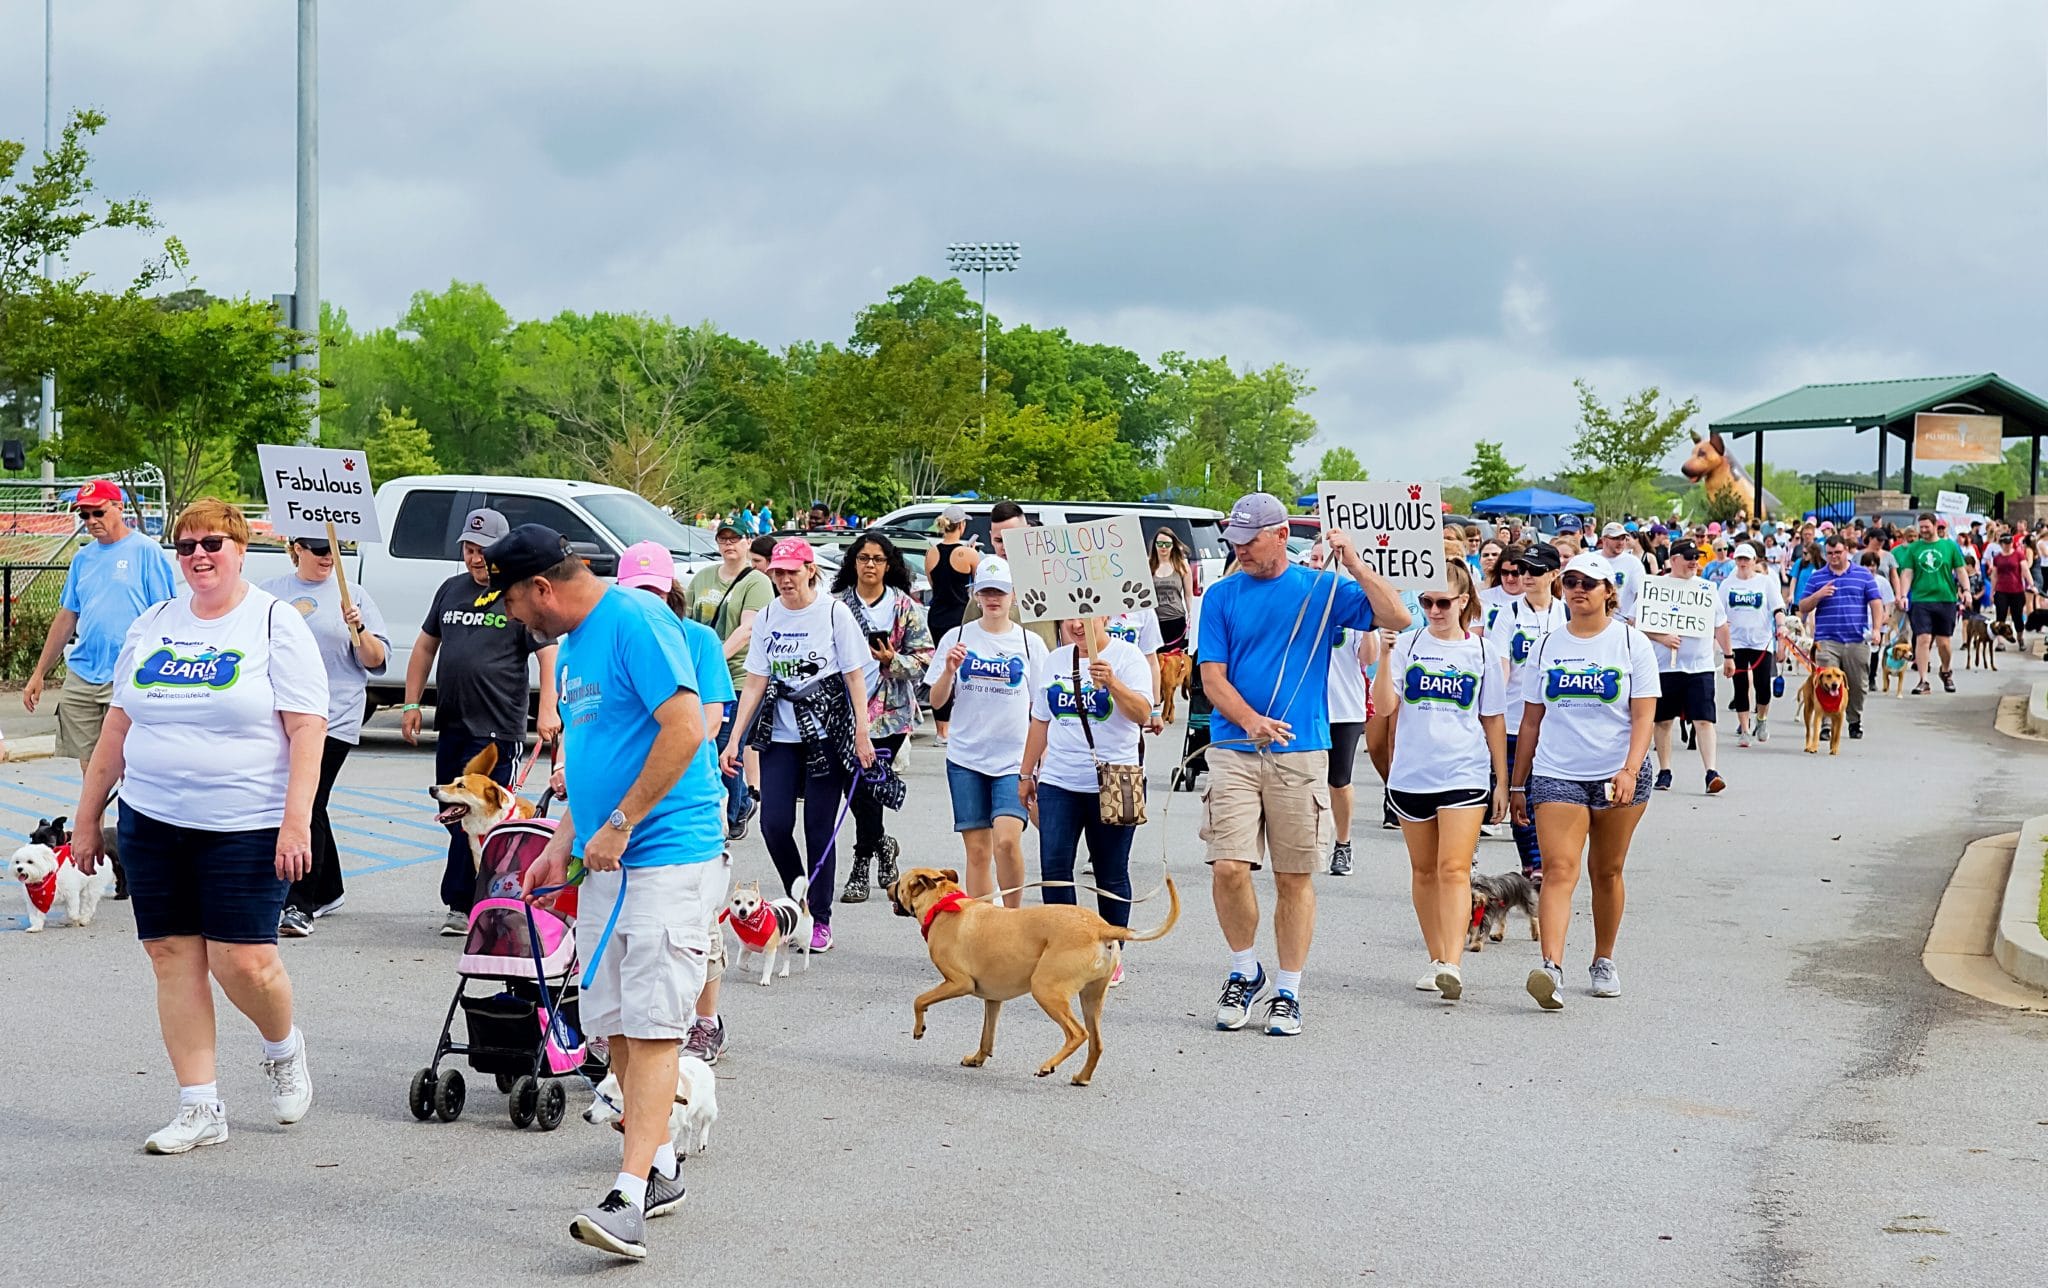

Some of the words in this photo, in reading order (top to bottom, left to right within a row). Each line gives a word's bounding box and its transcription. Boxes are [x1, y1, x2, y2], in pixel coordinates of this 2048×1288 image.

[275, 466, 362, 495] Fabulous
[287, 501, 361, 525] Fosters
[1326, 495, 1435, 531] FABULOUS
[1024, 524, 1123, 556] FABULOUS
[1042, 553, 1124, 585] FOSTERS
[1334, 548, 1434, 578] STERS
[1643, 581, 1713, 608] FABULOUS
[1734, 594, 1757, 606] BARK
[442, 610, 507, 628] #FORSC
[1641, 605, 1706, 632] FOSTERS
[764, 637, 799, 658] Meow
[158, 658, 221, 679] BARK
[971, 659, 1010, 674] BARK
[1420, 676, 1463, 694] BARK
[1559, 673, 1604, 689] BARK
